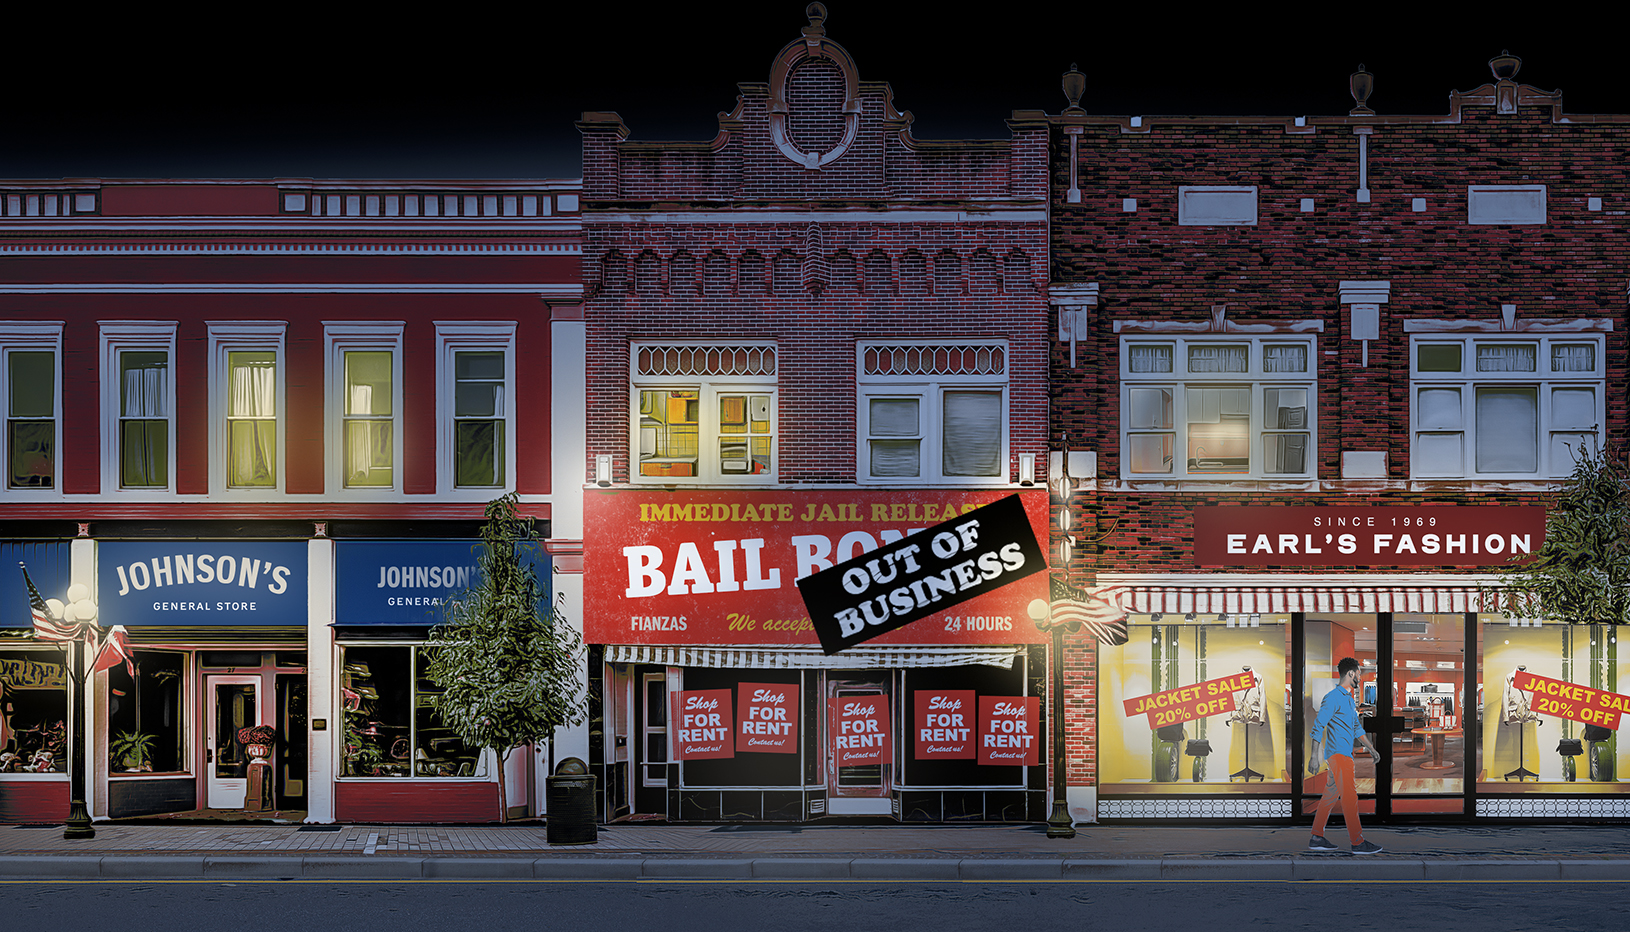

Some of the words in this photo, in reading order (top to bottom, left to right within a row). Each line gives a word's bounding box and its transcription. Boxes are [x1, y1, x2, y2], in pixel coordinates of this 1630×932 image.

[639, 504, 794, 522] IMMEDIATE
[801, 504, 863, 522] JAIL
[871, 504, 989, 522] RELEAS
[1313, 517, 1375, 527] SINCE
[1391, 517, 1437, 527] 1969
[1227, 533, 1357, 554] EARL'S
[1374, 533, 1531, 554] FASHION
[842, 544, 920, 594] OUT
[931, 519, 980, 559] OF
[117, 554, 291, 596] JOHNSON'S
[622, 538, 781, 598] BAIL
[377, 566, 476, 589] JOHNSON'
[833, 542, 1025, 638] BUSINESS
[153, 602, 211, 611] GENERAL
[216, 602, 257, 611] STORE
[387, 597, 445, 606] GENERAL
[631, 616, 688, 631] FIANZAS
[726, 613, 756, 632] We
[944, 617, 962, 632] 24
[966, 616, 1013, 632] HOURS
[751, 689, 785, 706] Shop
[1135, 686, 1202, 713] JACKET
[1207, 675, 1252, 696] SALE
[1524, 678, 1596, 704] JACKET
[1599, 694, 1630, 713] SAL
[685, 696, 718, 712] Shop
[842, 703, 876, 718] Shop
[928, 696, 962, 712] Shop
[992, 702, 1026, 719] Shop
[1537, 698, 1574, 718] 20%
[1580, 708, 1615, 725] OFF
[749, 706, 787, 721] FOR
[1155, 707, 1191, 726] 20%
[1195, 698, 1228, 716] OFF
[684, 713, 721, 727] FOR
[841, 719, 879, 734] FOR
[927, 714, 965, 727] FOR
[990, 720, 1028, 734] FOR
[678, 728, 728, 742] RENT
[742, 721, 792, 735] RENT
[920, 728, 970, 742] RENT
[748, 738, 774, 746] Contact
[835, 733, 885, 749] RENT
[984, 734, 1034, 748] RENT
[685, 745, 710, 754] Contact
[843, 751, 868, 760] Contact
[926, 745, 951, 753] Contact
[989, 751, 1014, 759] Contact
[1015, 751, 1027, 759] us!
